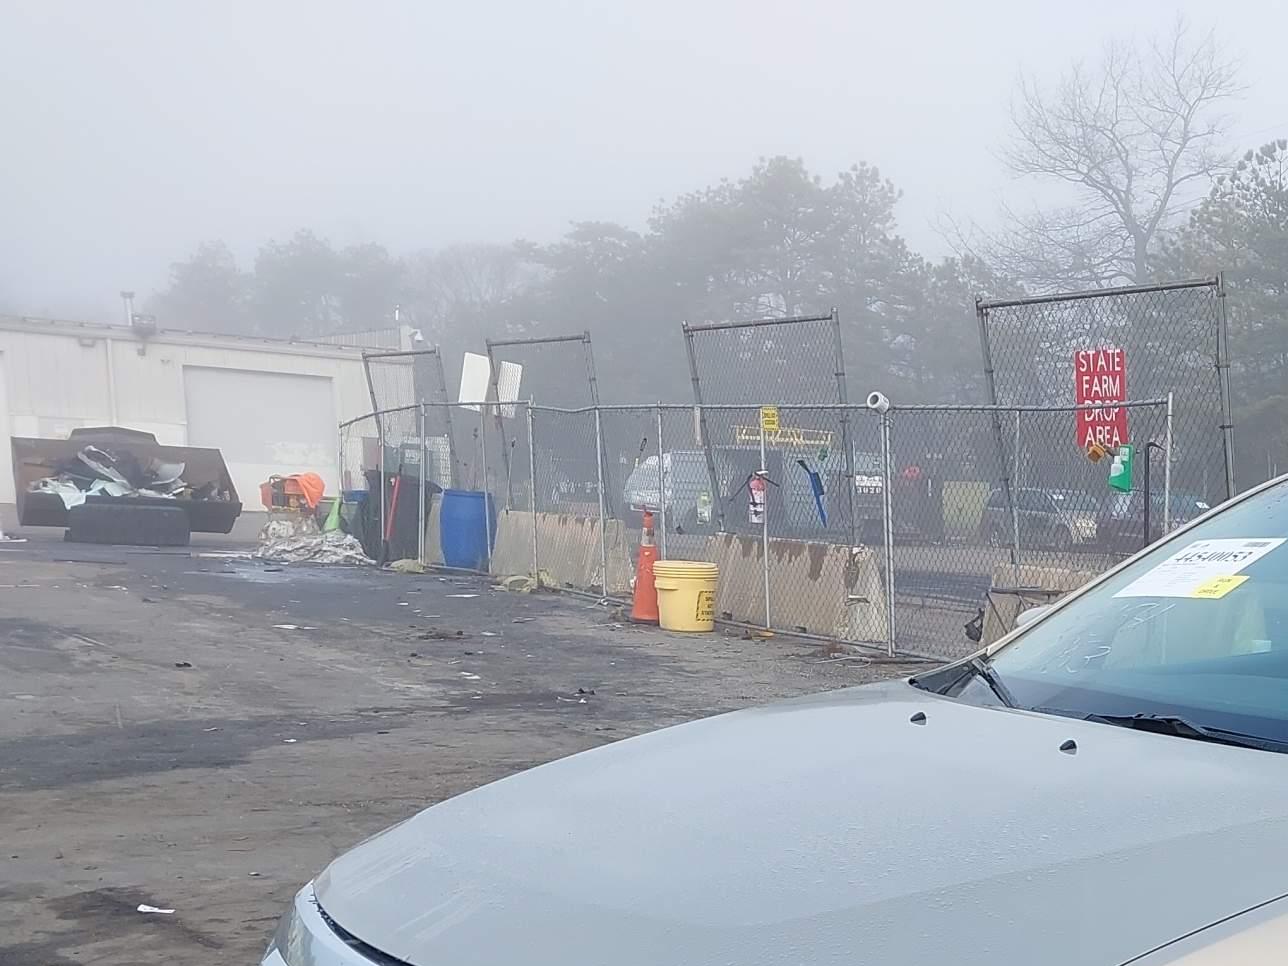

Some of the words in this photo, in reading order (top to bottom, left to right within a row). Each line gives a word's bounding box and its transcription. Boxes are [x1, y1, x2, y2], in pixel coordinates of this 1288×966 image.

[1079, 348, 1121, 372] STATE
[1082, 375, 1120, 397] FARM
[1084, 400, 1120, 421] DROP
[1085, 426, 1121, 448] AREA
[1174, 551, 1254, 562] 44540053
